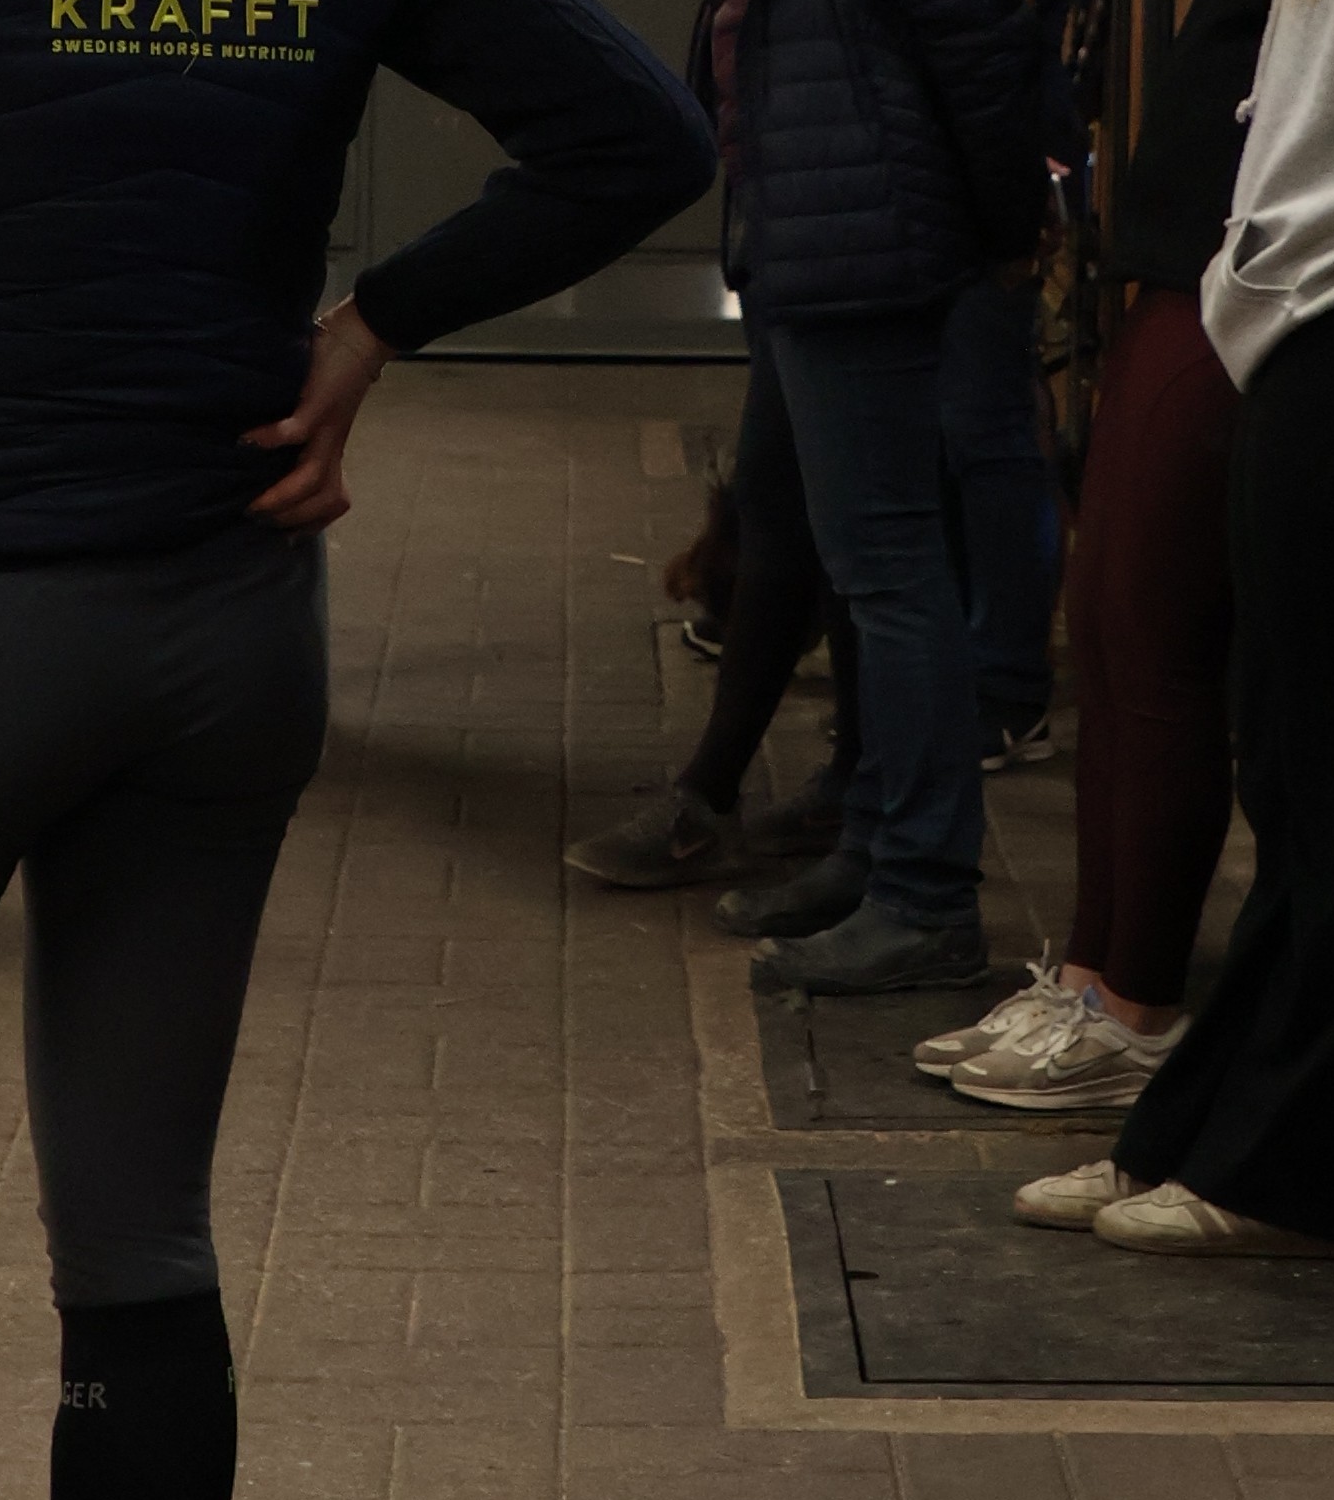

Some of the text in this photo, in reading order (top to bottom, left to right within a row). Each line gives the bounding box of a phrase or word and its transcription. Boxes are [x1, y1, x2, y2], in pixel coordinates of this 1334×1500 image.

[51, 38, 316, 63] SWEDISH HORSE NUTRITION
